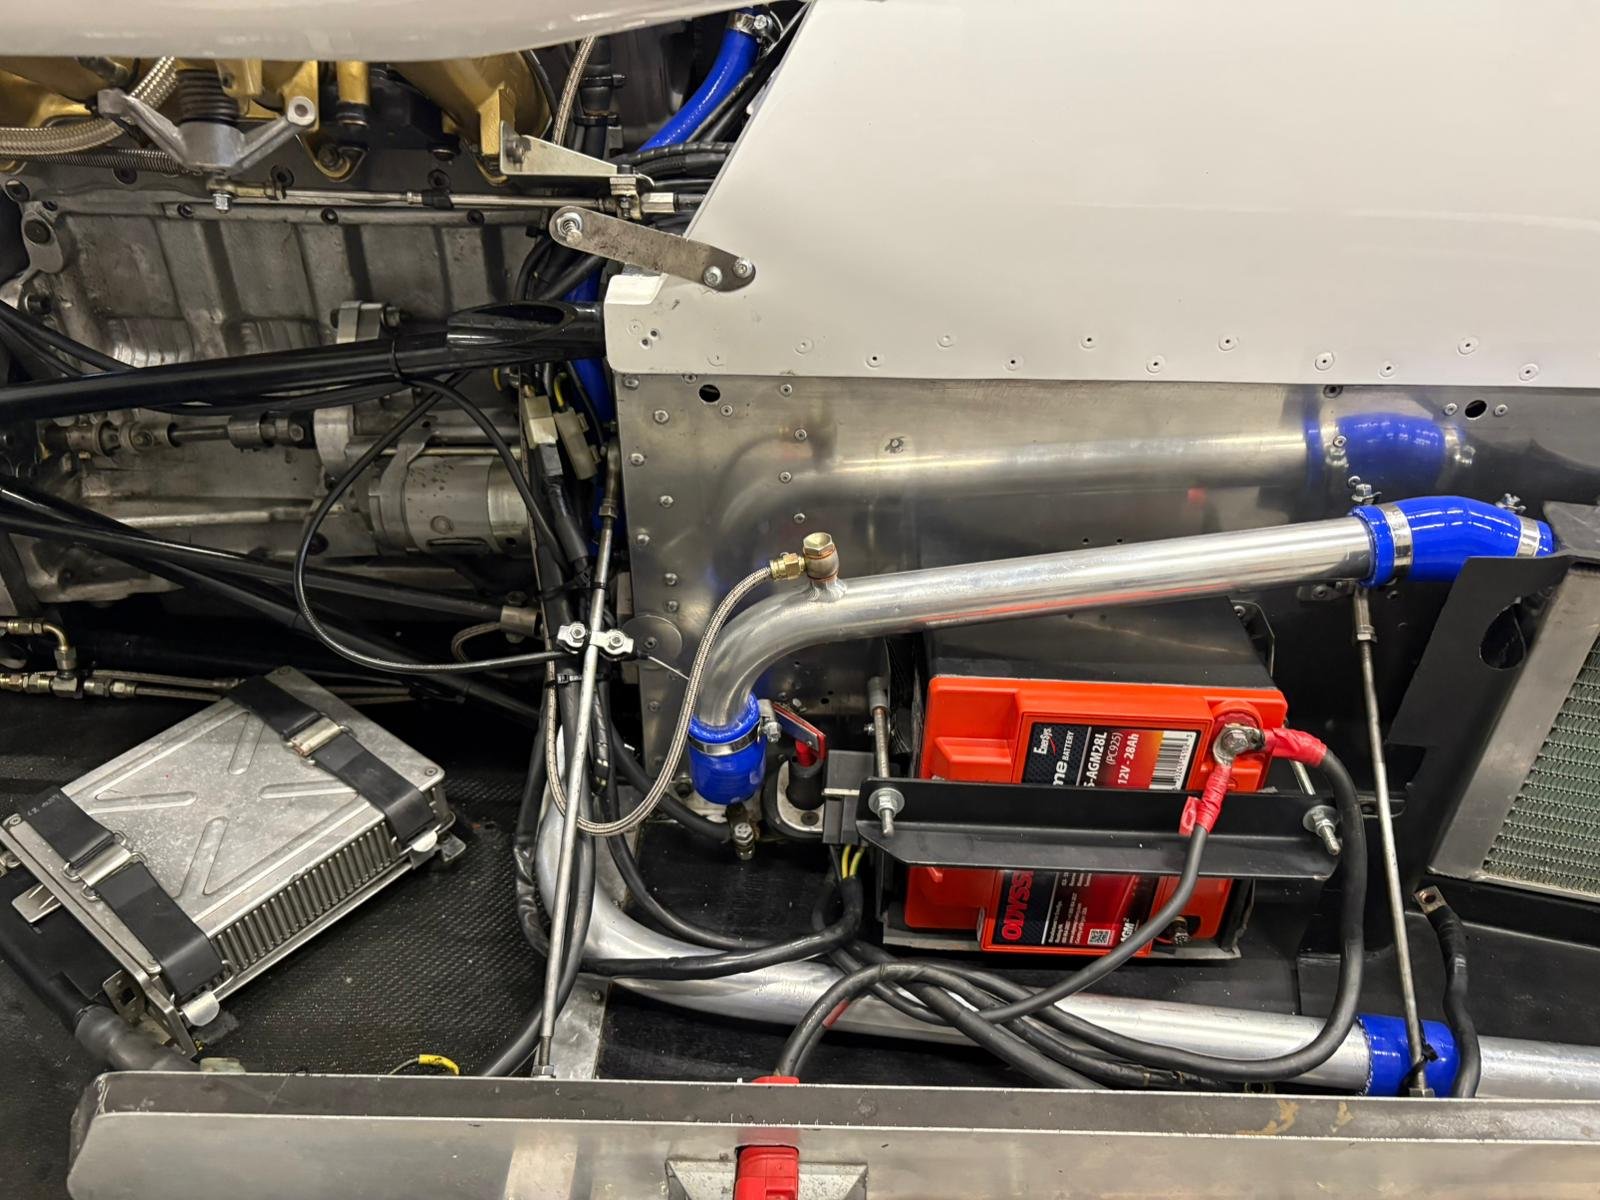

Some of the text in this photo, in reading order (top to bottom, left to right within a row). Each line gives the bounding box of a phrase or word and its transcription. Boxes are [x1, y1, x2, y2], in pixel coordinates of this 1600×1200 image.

[1033, 727, 1053, 755] EnerSys
[1062, 730, 1075, 761] BATTERY
[1105, 732, 1125, 766] (PC925)
[1117, 765, 1131, 785] 12V
[1124, 732, 1140, 760] 28Ah
[1001, 870, 1035, 942] ODYSS
